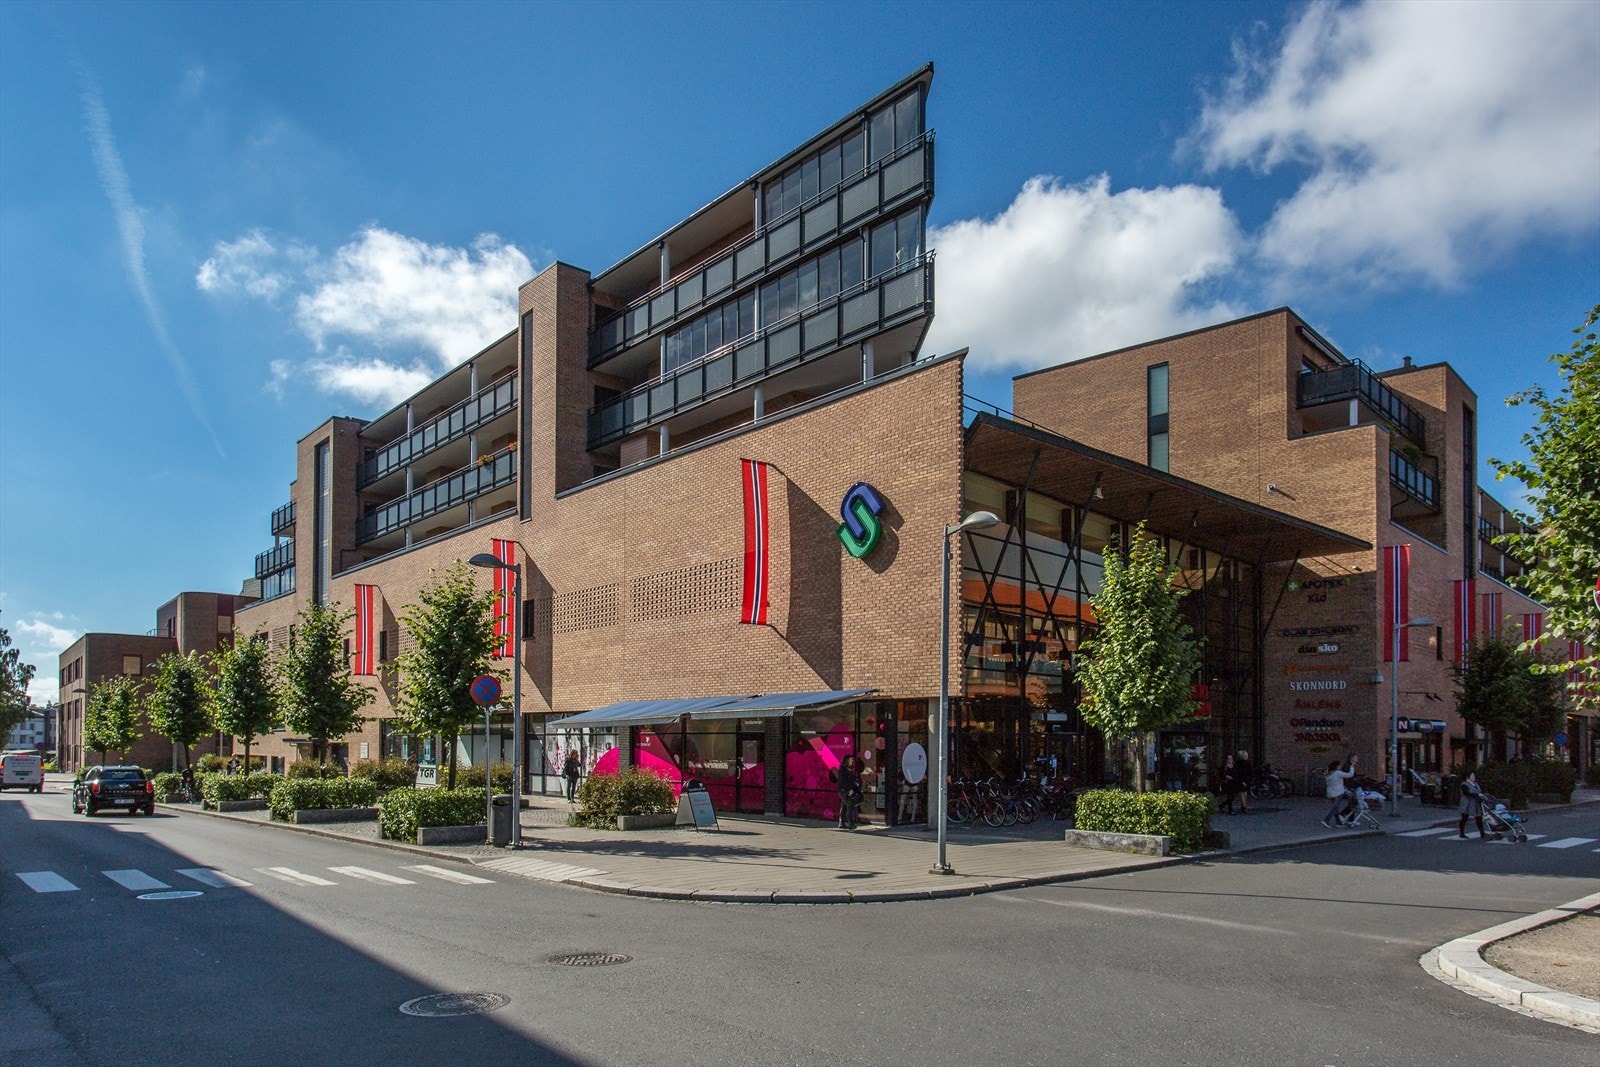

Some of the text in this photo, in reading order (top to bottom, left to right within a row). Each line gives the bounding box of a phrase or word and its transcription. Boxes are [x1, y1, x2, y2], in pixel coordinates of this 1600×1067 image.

[1301, 578, 1344, 589] APOTEK
[1308, 593, 1327, 603] Kid
[1290, 681, 1347, 691] SKONNORD
[1300, 718, 1344, 727] Panduro
